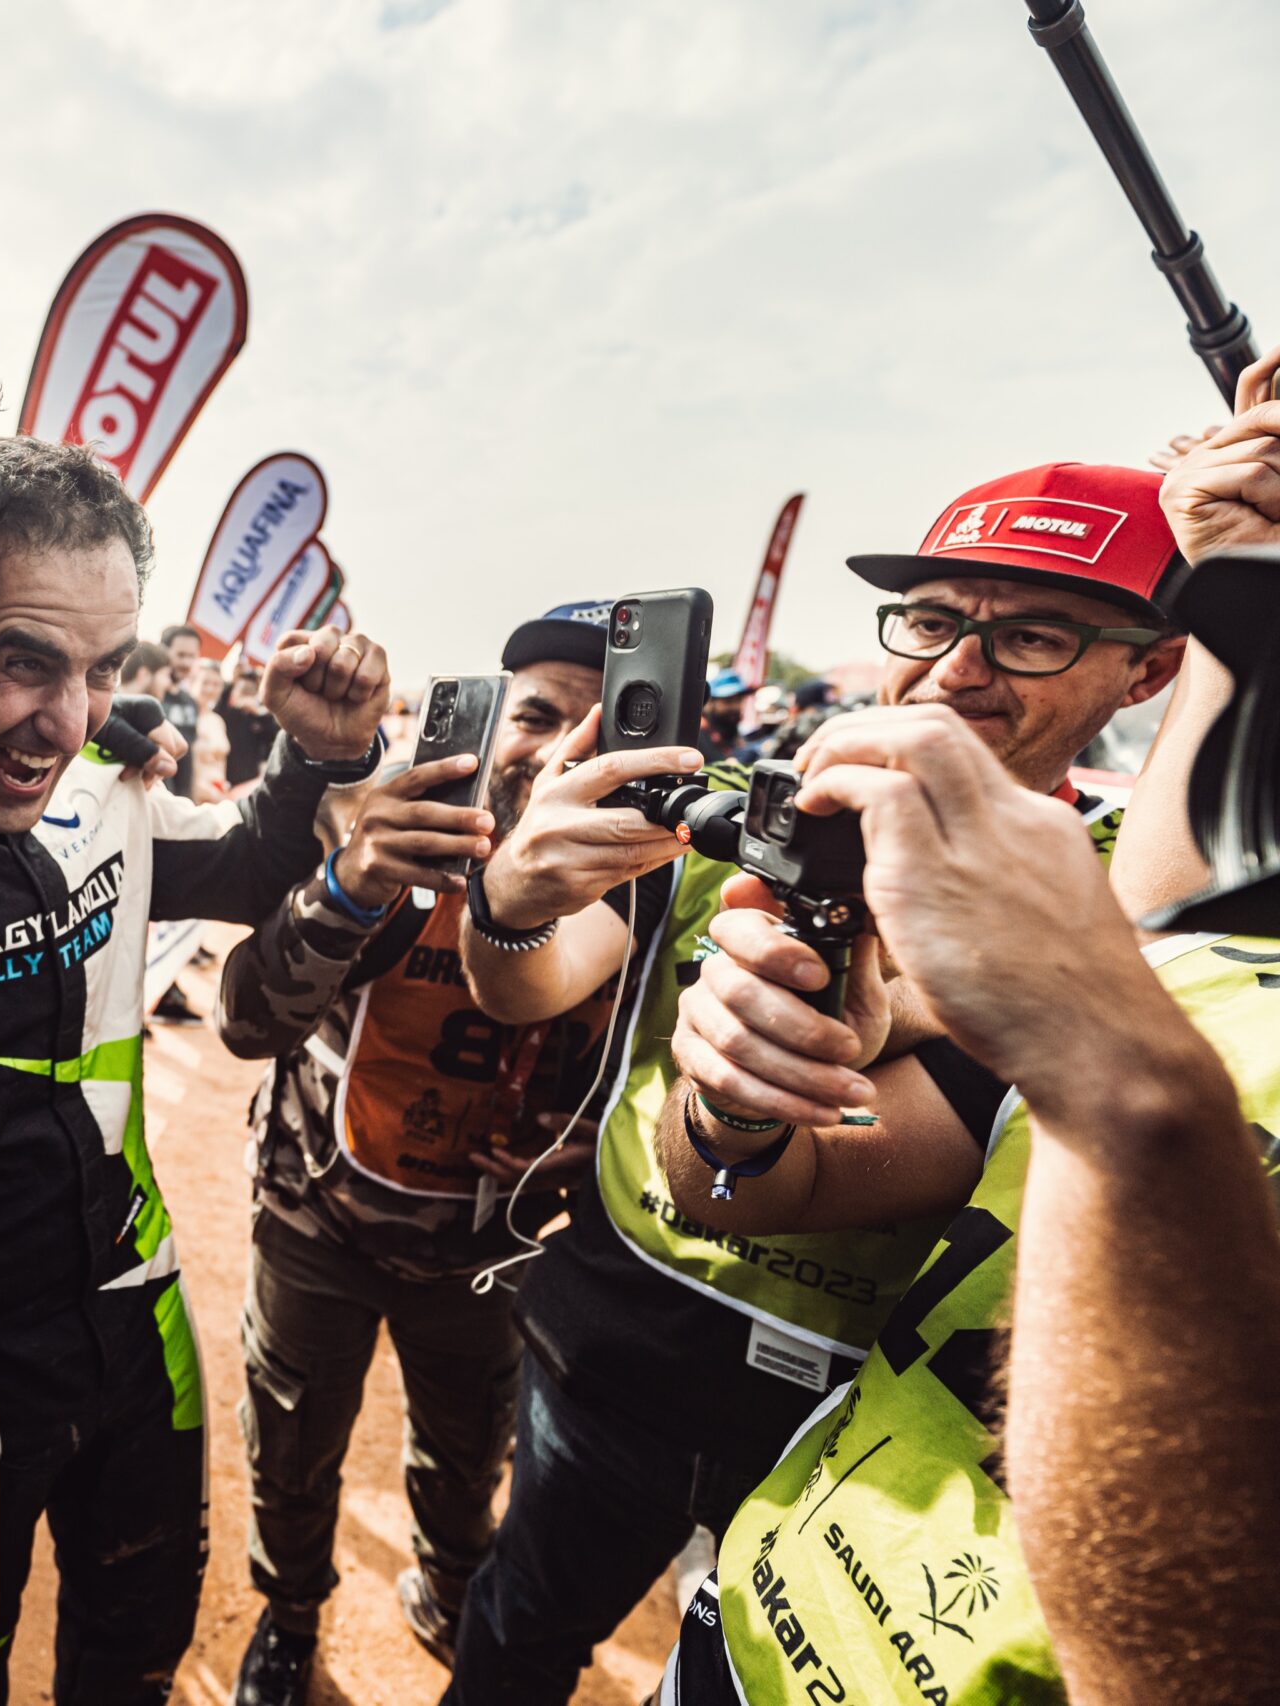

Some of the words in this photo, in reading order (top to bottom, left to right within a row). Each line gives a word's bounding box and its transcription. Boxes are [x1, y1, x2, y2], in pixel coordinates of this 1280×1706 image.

[79, 270, 204, 480] OTUL
[213, 478, 311, 619] AQUAFINA
[1010, 515, 1088, 537] MOTUL
[59, 911, 113, 969] TEAM
[638, 1190, 878, 1306] #Dakar2023
[751, 1522, 855, 1706] #Dakar2
[823, 1522, 892, 1627] SAUDI
